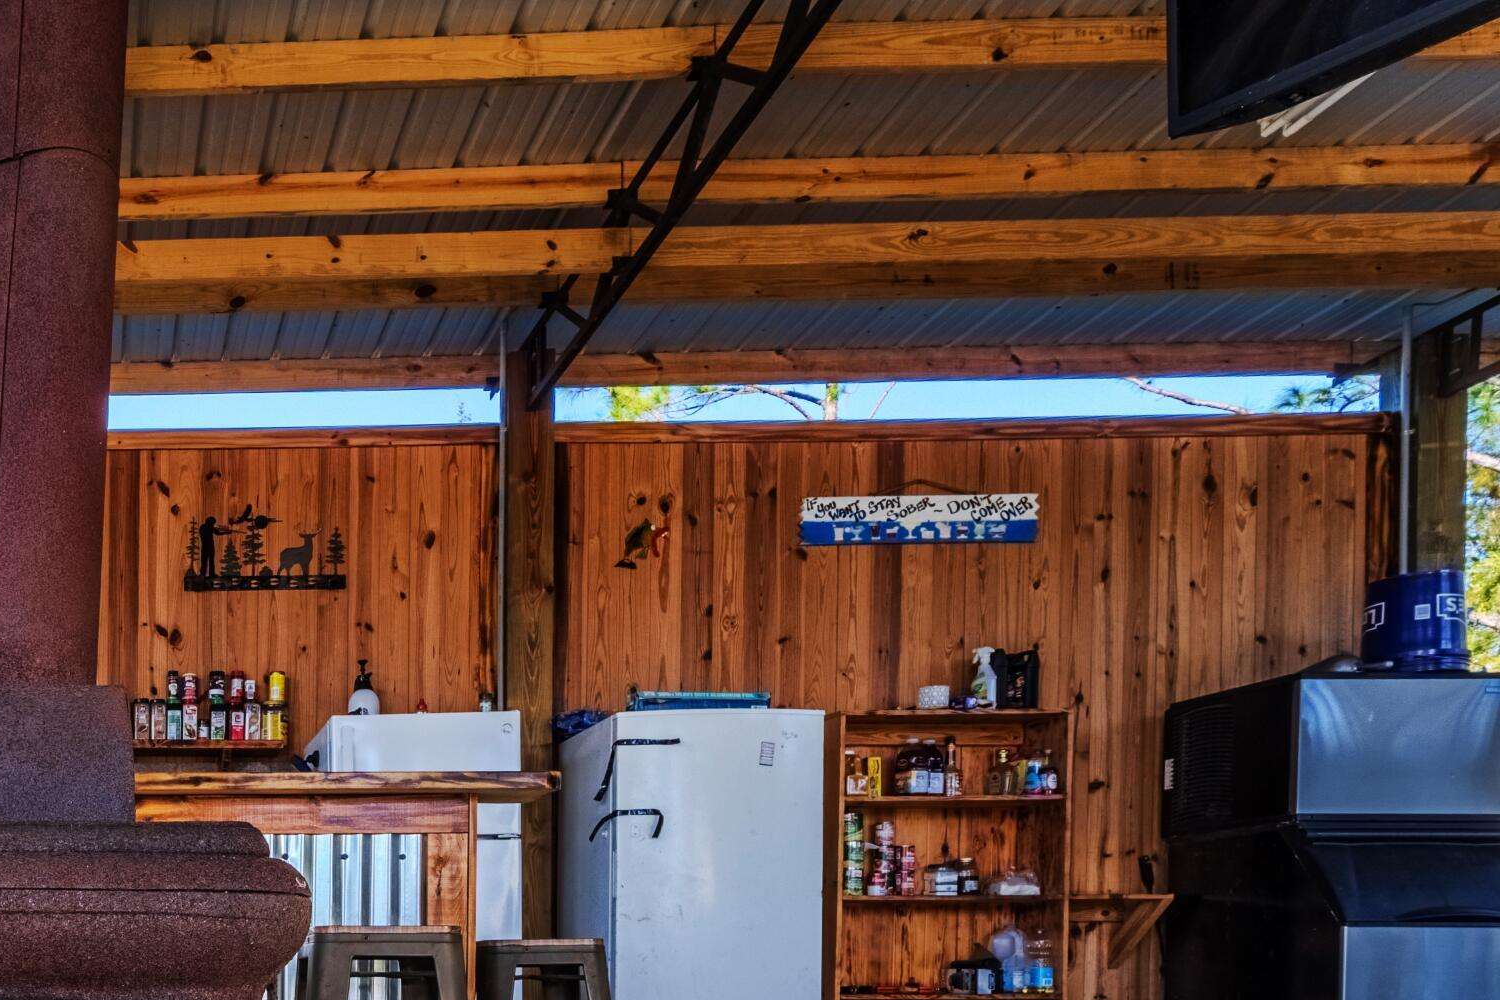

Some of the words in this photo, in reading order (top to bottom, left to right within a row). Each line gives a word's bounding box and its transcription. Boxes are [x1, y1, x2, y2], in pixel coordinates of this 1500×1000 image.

[828, 500, 860, 520] WANT
[849, 509, 867, 522] TO
[867, 497, 901, 514] STAY
[886, 497, 936, 522] SOBER
[947, 495, 992, 514] DON'T
[970, 497, 1006, 522] COME
[999, 496, 1034, 522] OVER
